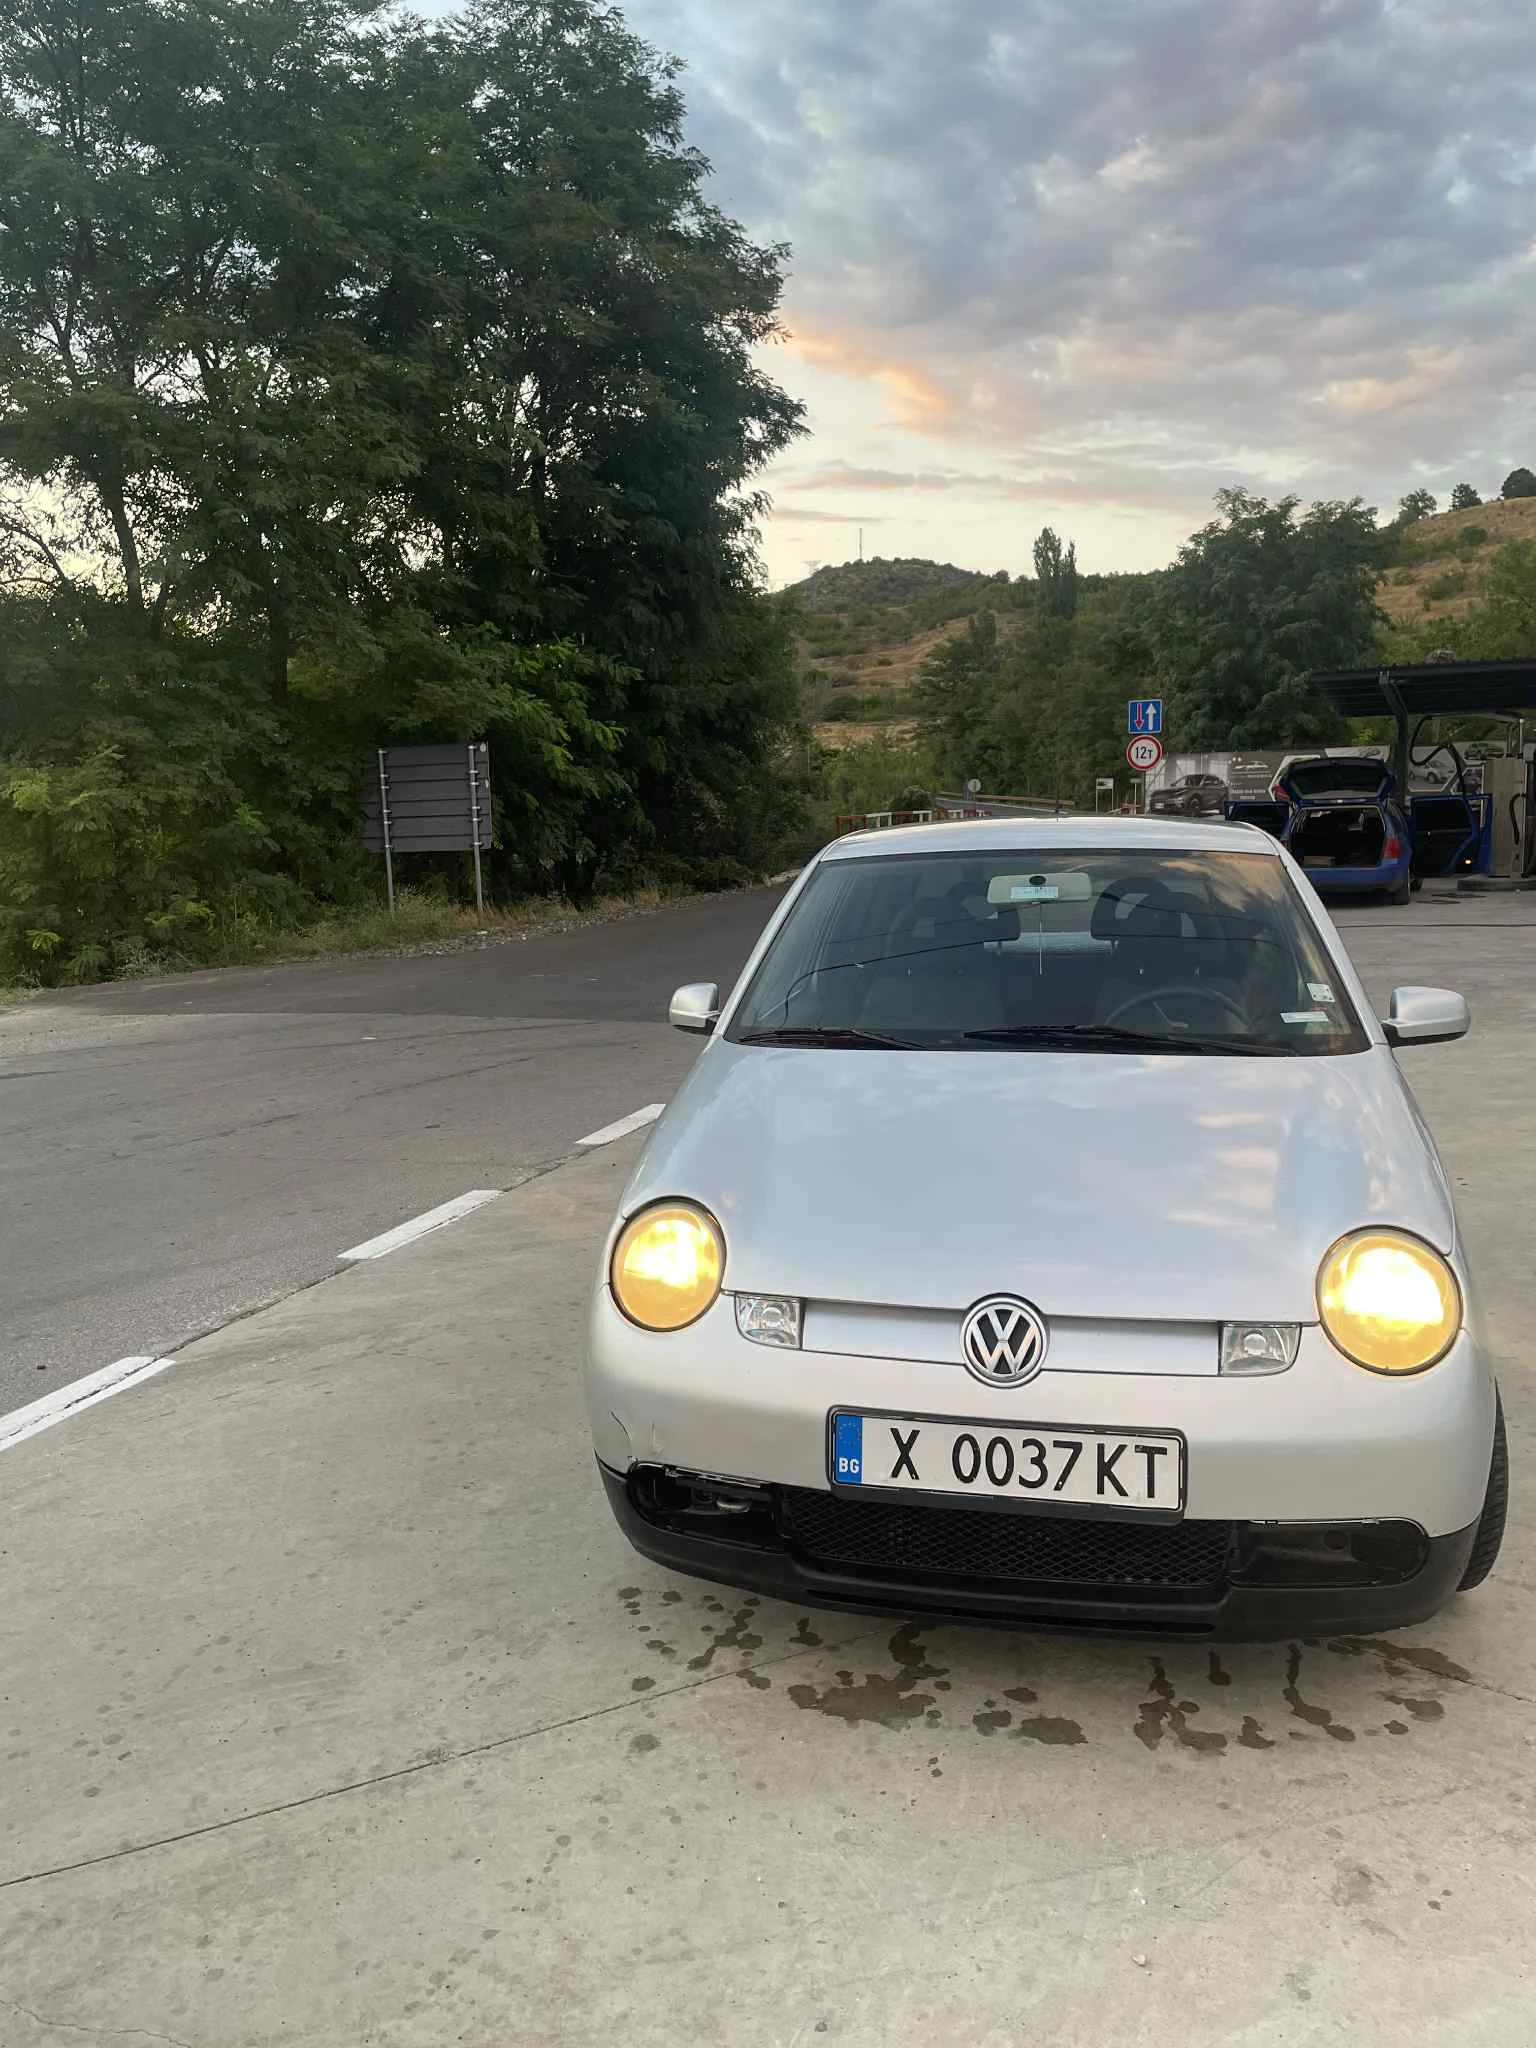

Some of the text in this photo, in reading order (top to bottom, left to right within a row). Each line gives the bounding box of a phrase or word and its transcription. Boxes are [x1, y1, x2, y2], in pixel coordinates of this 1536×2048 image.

[838, 1457, 860, 1473] BG
[890, 1427, 1168, 1499] X 0037 KT
